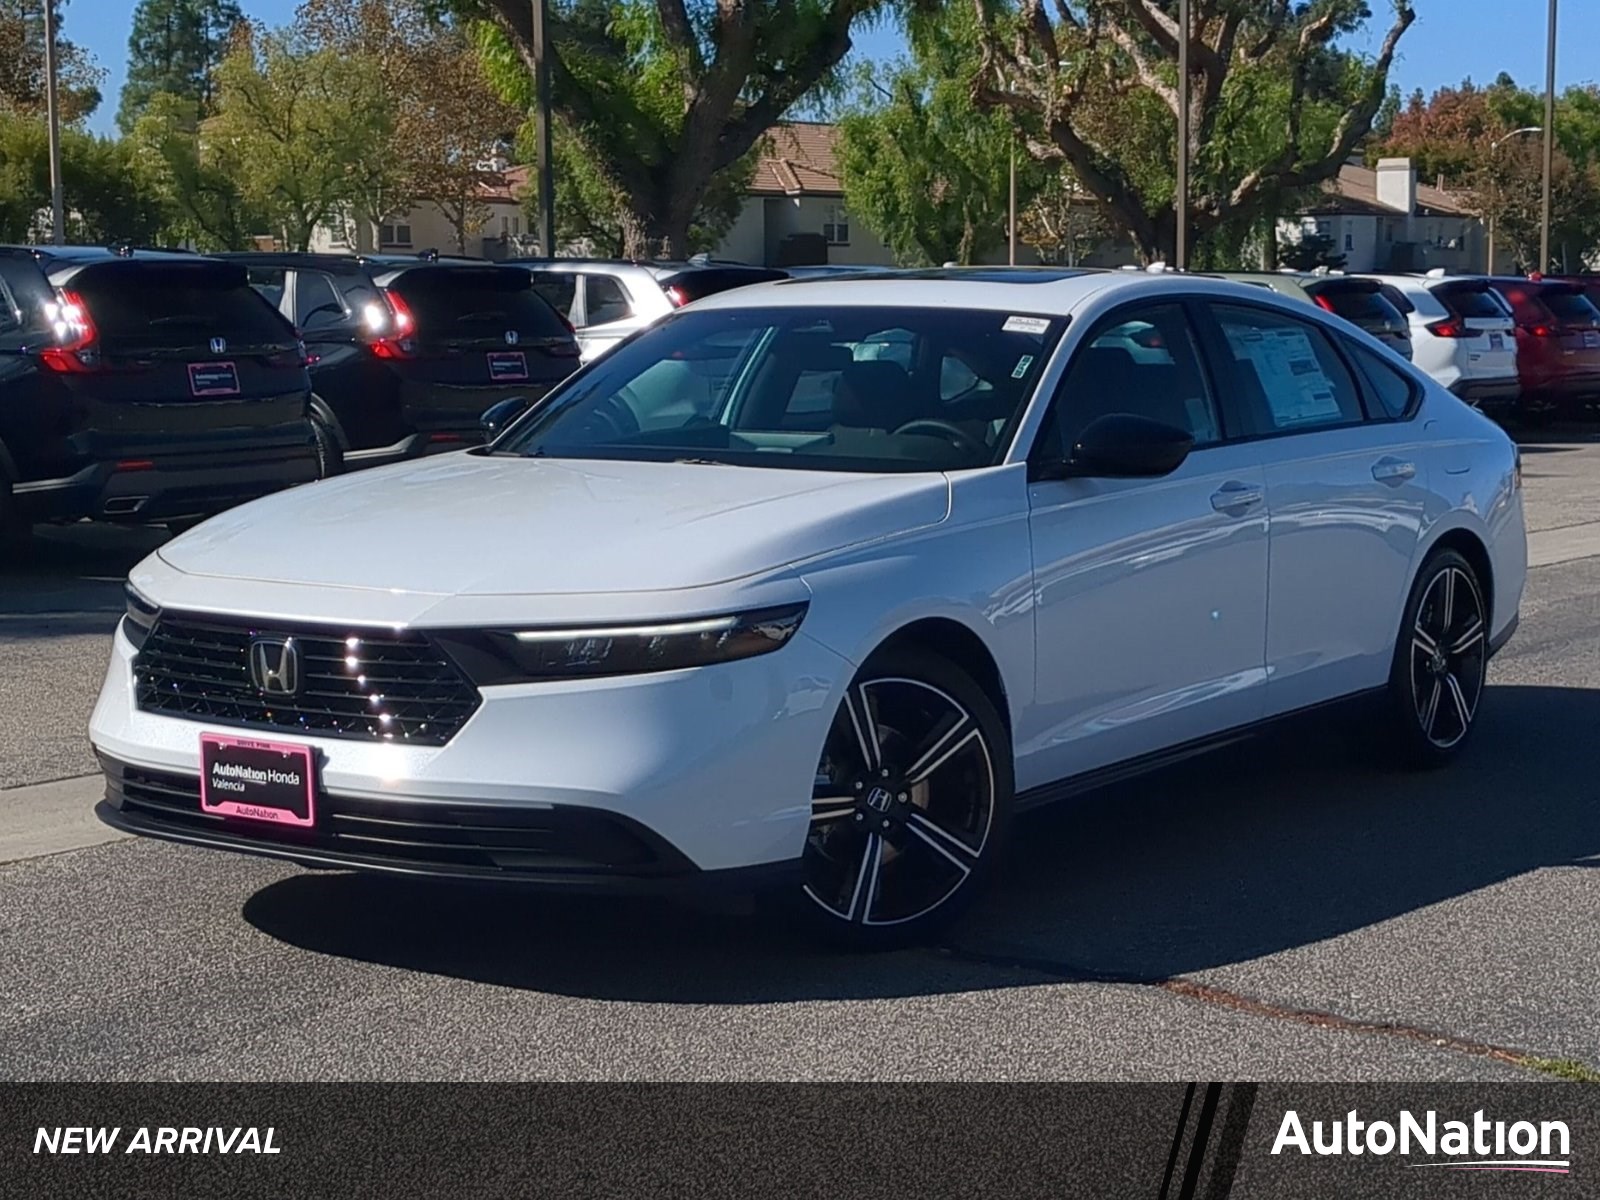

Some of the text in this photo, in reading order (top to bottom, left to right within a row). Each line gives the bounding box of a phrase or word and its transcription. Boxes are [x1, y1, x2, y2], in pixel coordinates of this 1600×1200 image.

[212, 762, 300, 785] AutoNation Honda
[212, 778, 245, 792] Valencia
[235, 805, 278, 819] AutoNation
